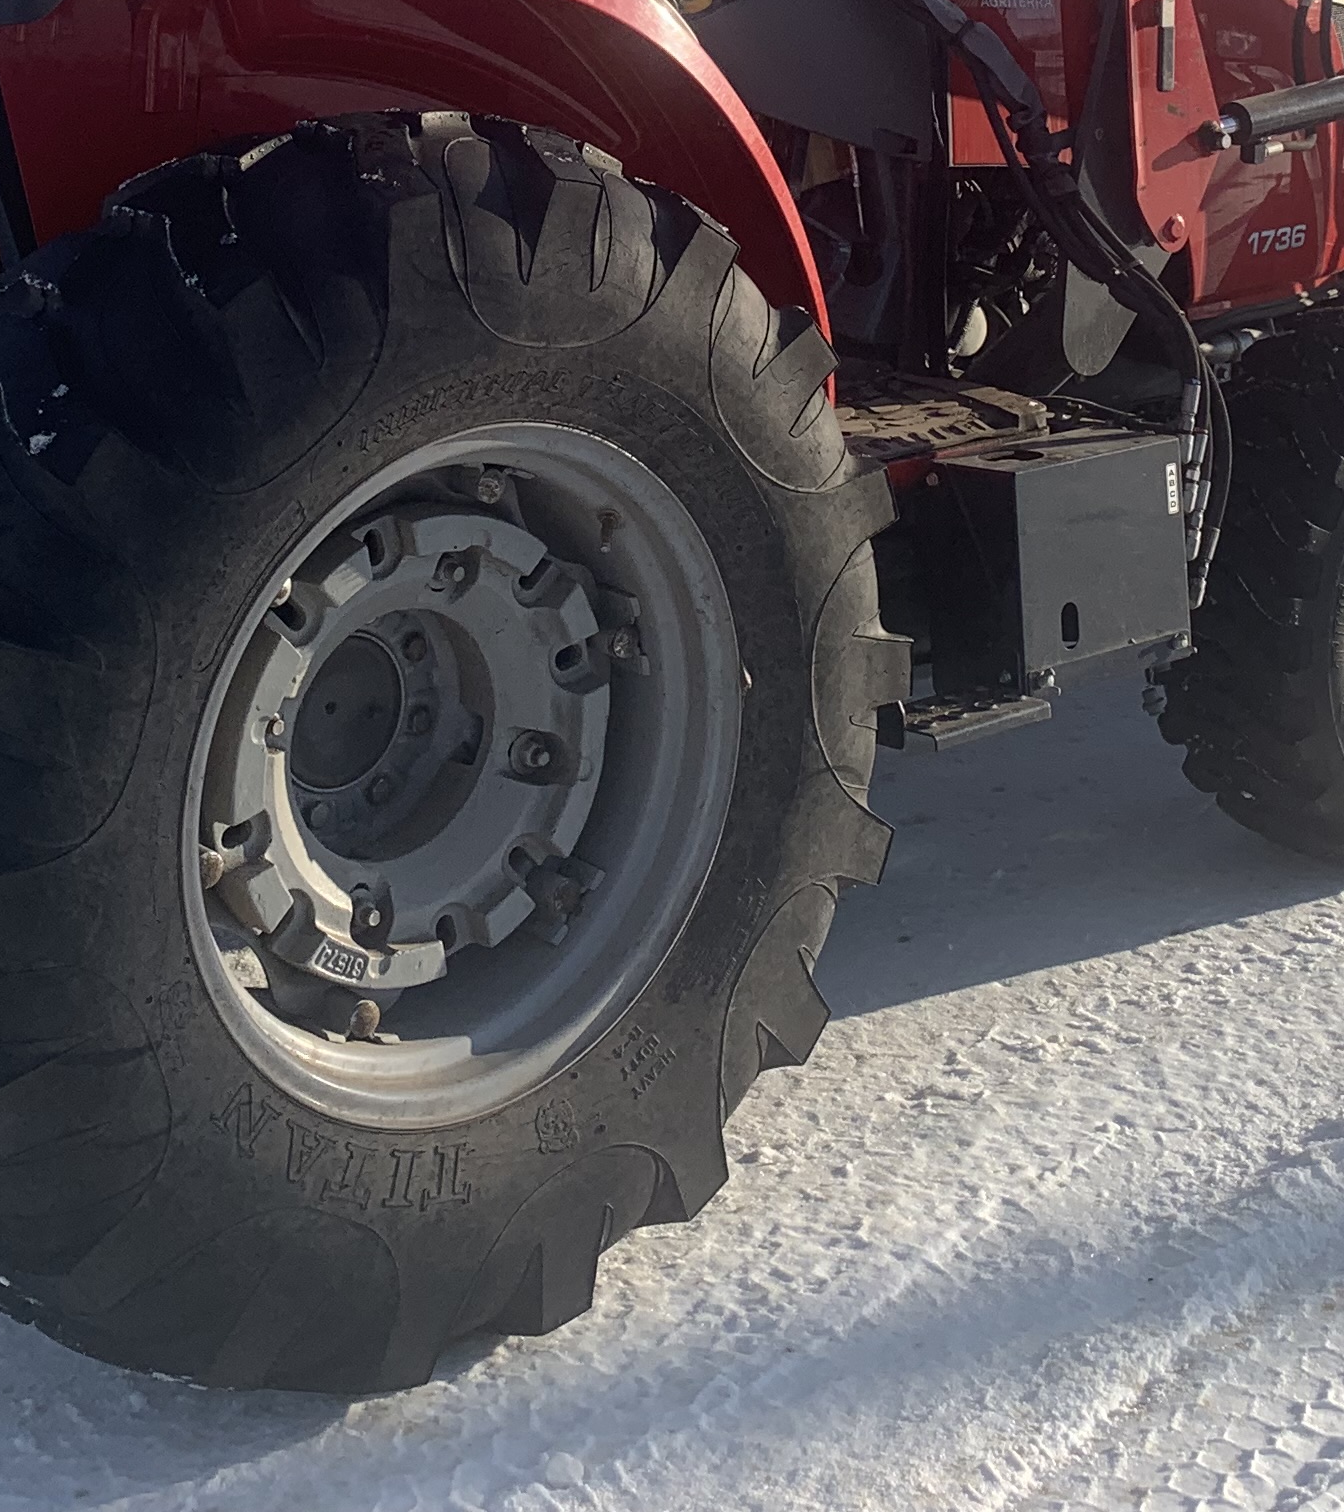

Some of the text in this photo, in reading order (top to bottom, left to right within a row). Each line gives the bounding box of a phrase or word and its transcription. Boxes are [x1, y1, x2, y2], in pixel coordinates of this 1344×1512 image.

[1248, 224, 1307, 255] 1736
[631, 1047, 677, 1100] HEAVY
[209, 1082, 476, 1212] TITAN
